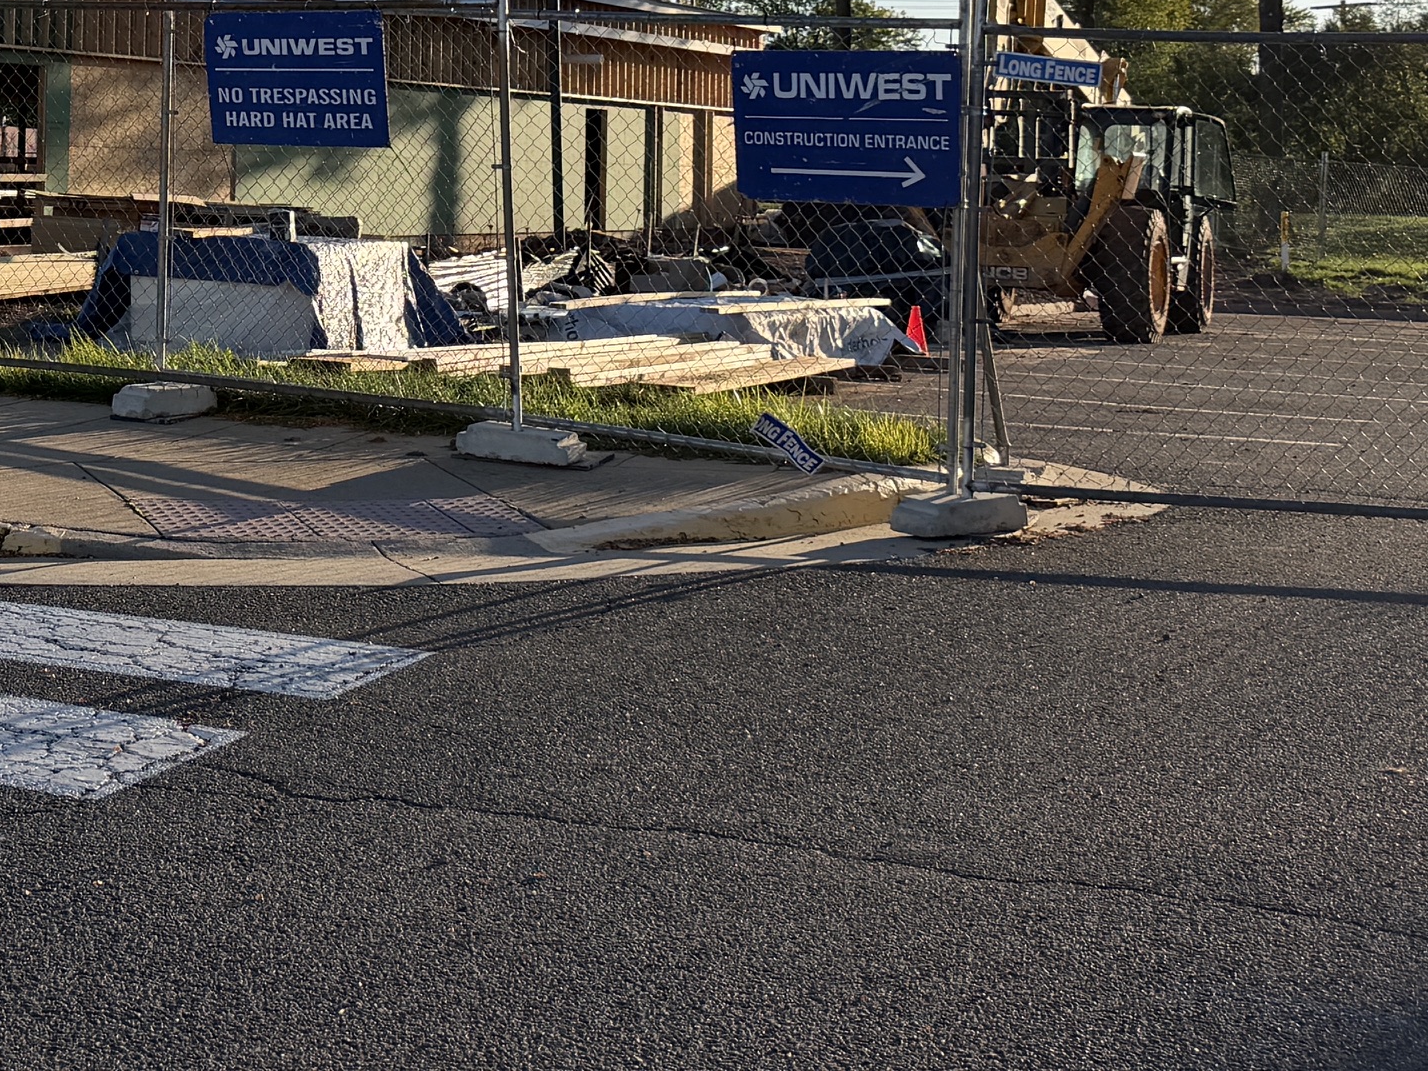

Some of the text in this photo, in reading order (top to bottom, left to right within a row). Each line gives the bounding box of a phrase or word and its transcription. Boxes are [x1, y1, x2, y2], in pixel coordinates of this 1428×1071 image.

[242, 38, 373, 55] UNIWEST
[999, 55, 1096, 84] LONG FENCE
[218, 87, 376, 105] NO TRESPASSING
[773, 73, 951, 101] UNIWEST
[225, 111, 374, 129] HARD HAT AREA
[744, 131, 950, 151] CONSTRUCTION ENTRANCE
[983, 267, 1028, 279] JCB
[776, 430, 818, 471] FENCE
